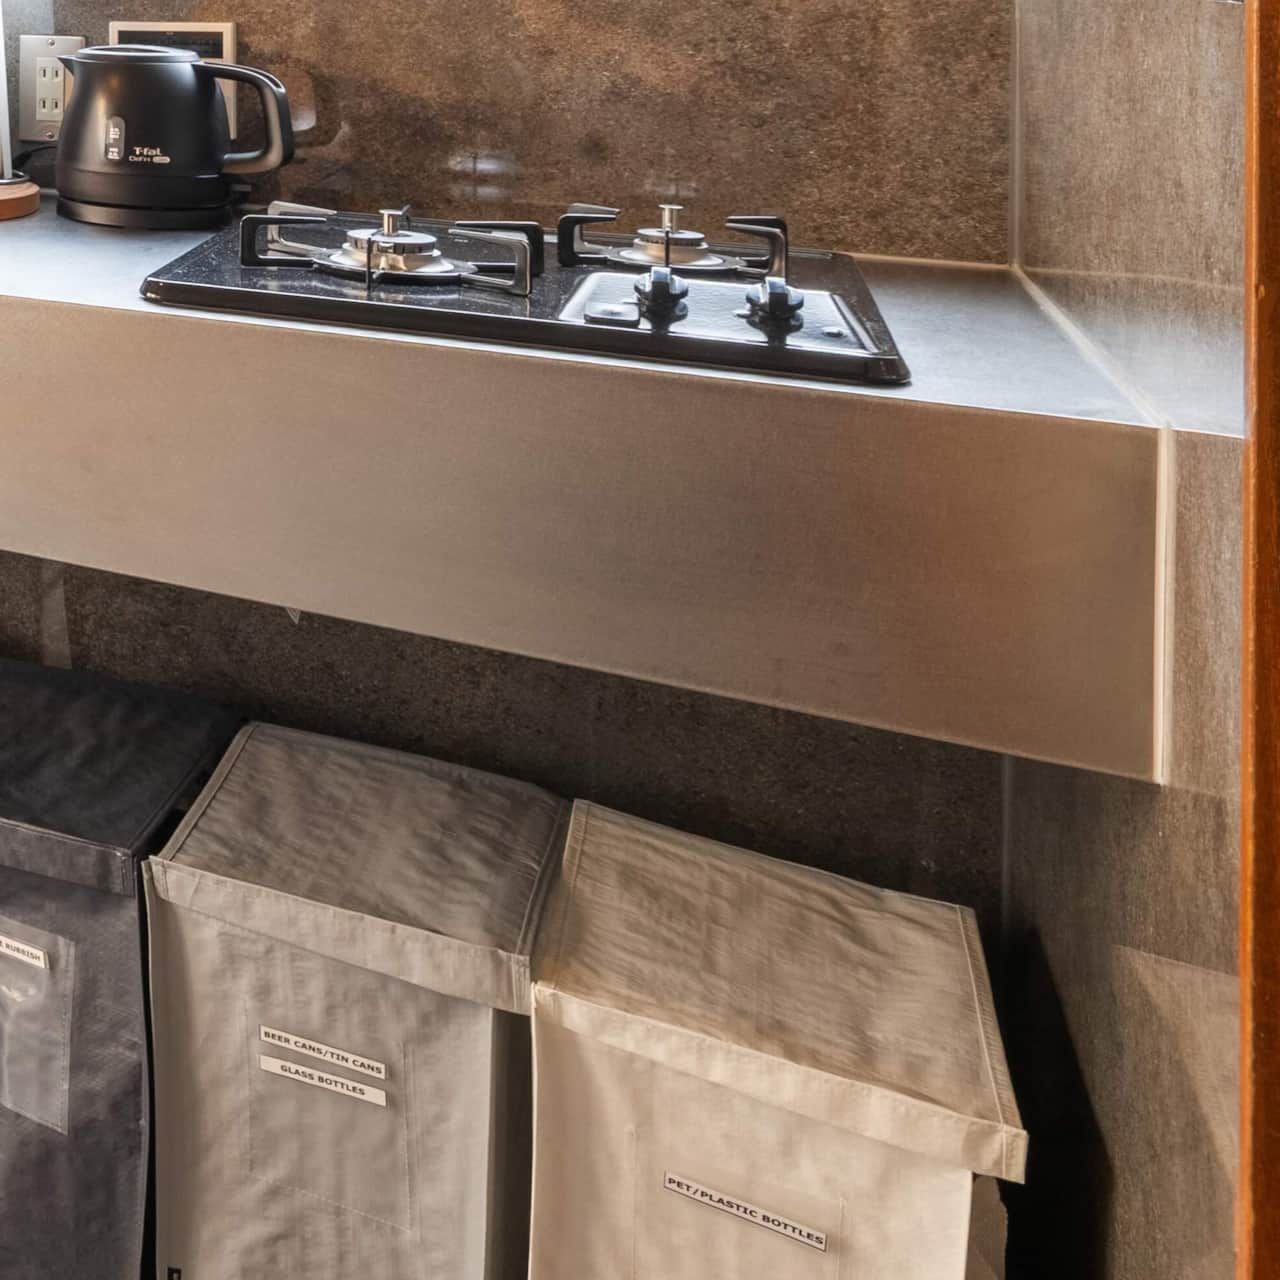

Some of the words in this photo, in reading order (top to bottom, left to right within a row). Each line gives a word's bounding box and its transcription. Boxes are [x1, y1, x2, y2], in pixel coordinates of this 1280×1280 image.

[5, 943, 41, 961] RUBBISH
[264, 1031, 291, 1045] BEER
[294, 1040, 349, 1063] CANS/TIN
[352, 1059, 382, 1074] CANS
[280, 1064, 314, 1080] GLASS
[318, 1075, 366, 1096] BOTTLES
[668, 1177, 758, 1218] PET/PLASTIC
[762, 1214, 824, 1245] BOTTLES
